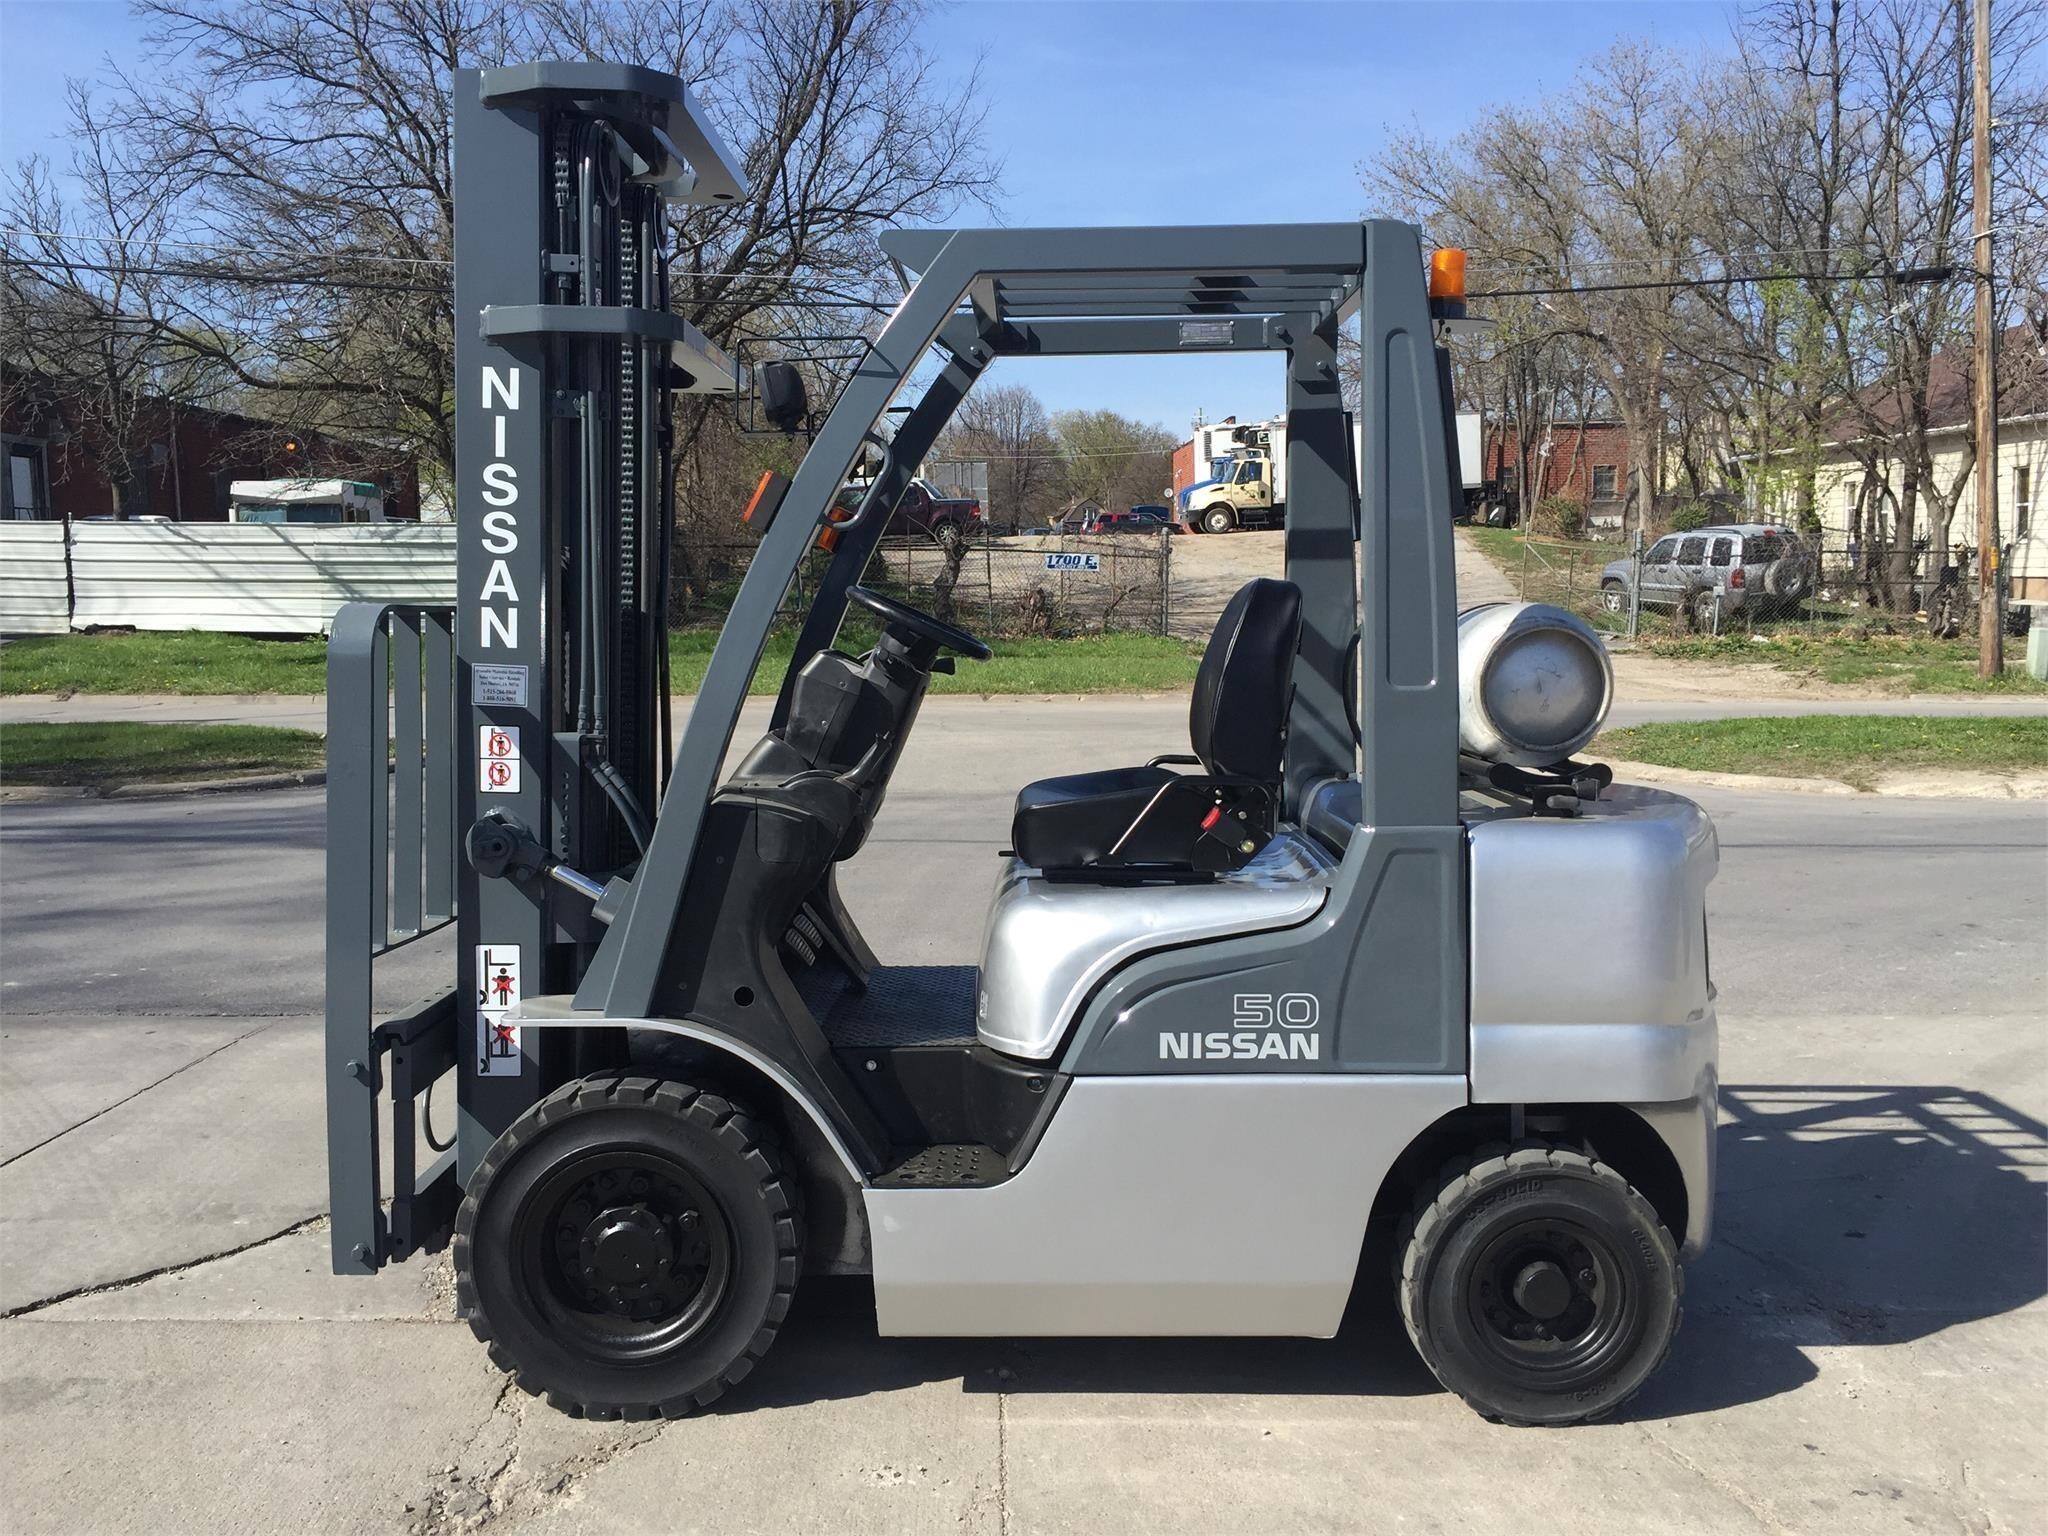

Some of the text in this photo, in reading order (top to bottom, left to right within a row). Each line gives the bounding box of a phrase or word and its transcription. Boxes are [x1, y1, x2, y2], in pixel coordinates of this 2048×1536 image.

[480, 366, 520, 649] NISSAN
[1047, 555, 1097, 566] 1700 E.
[1233, 992, 1319, 1029] 50
[1159, 1032, 1319, 1060] NISSAN
